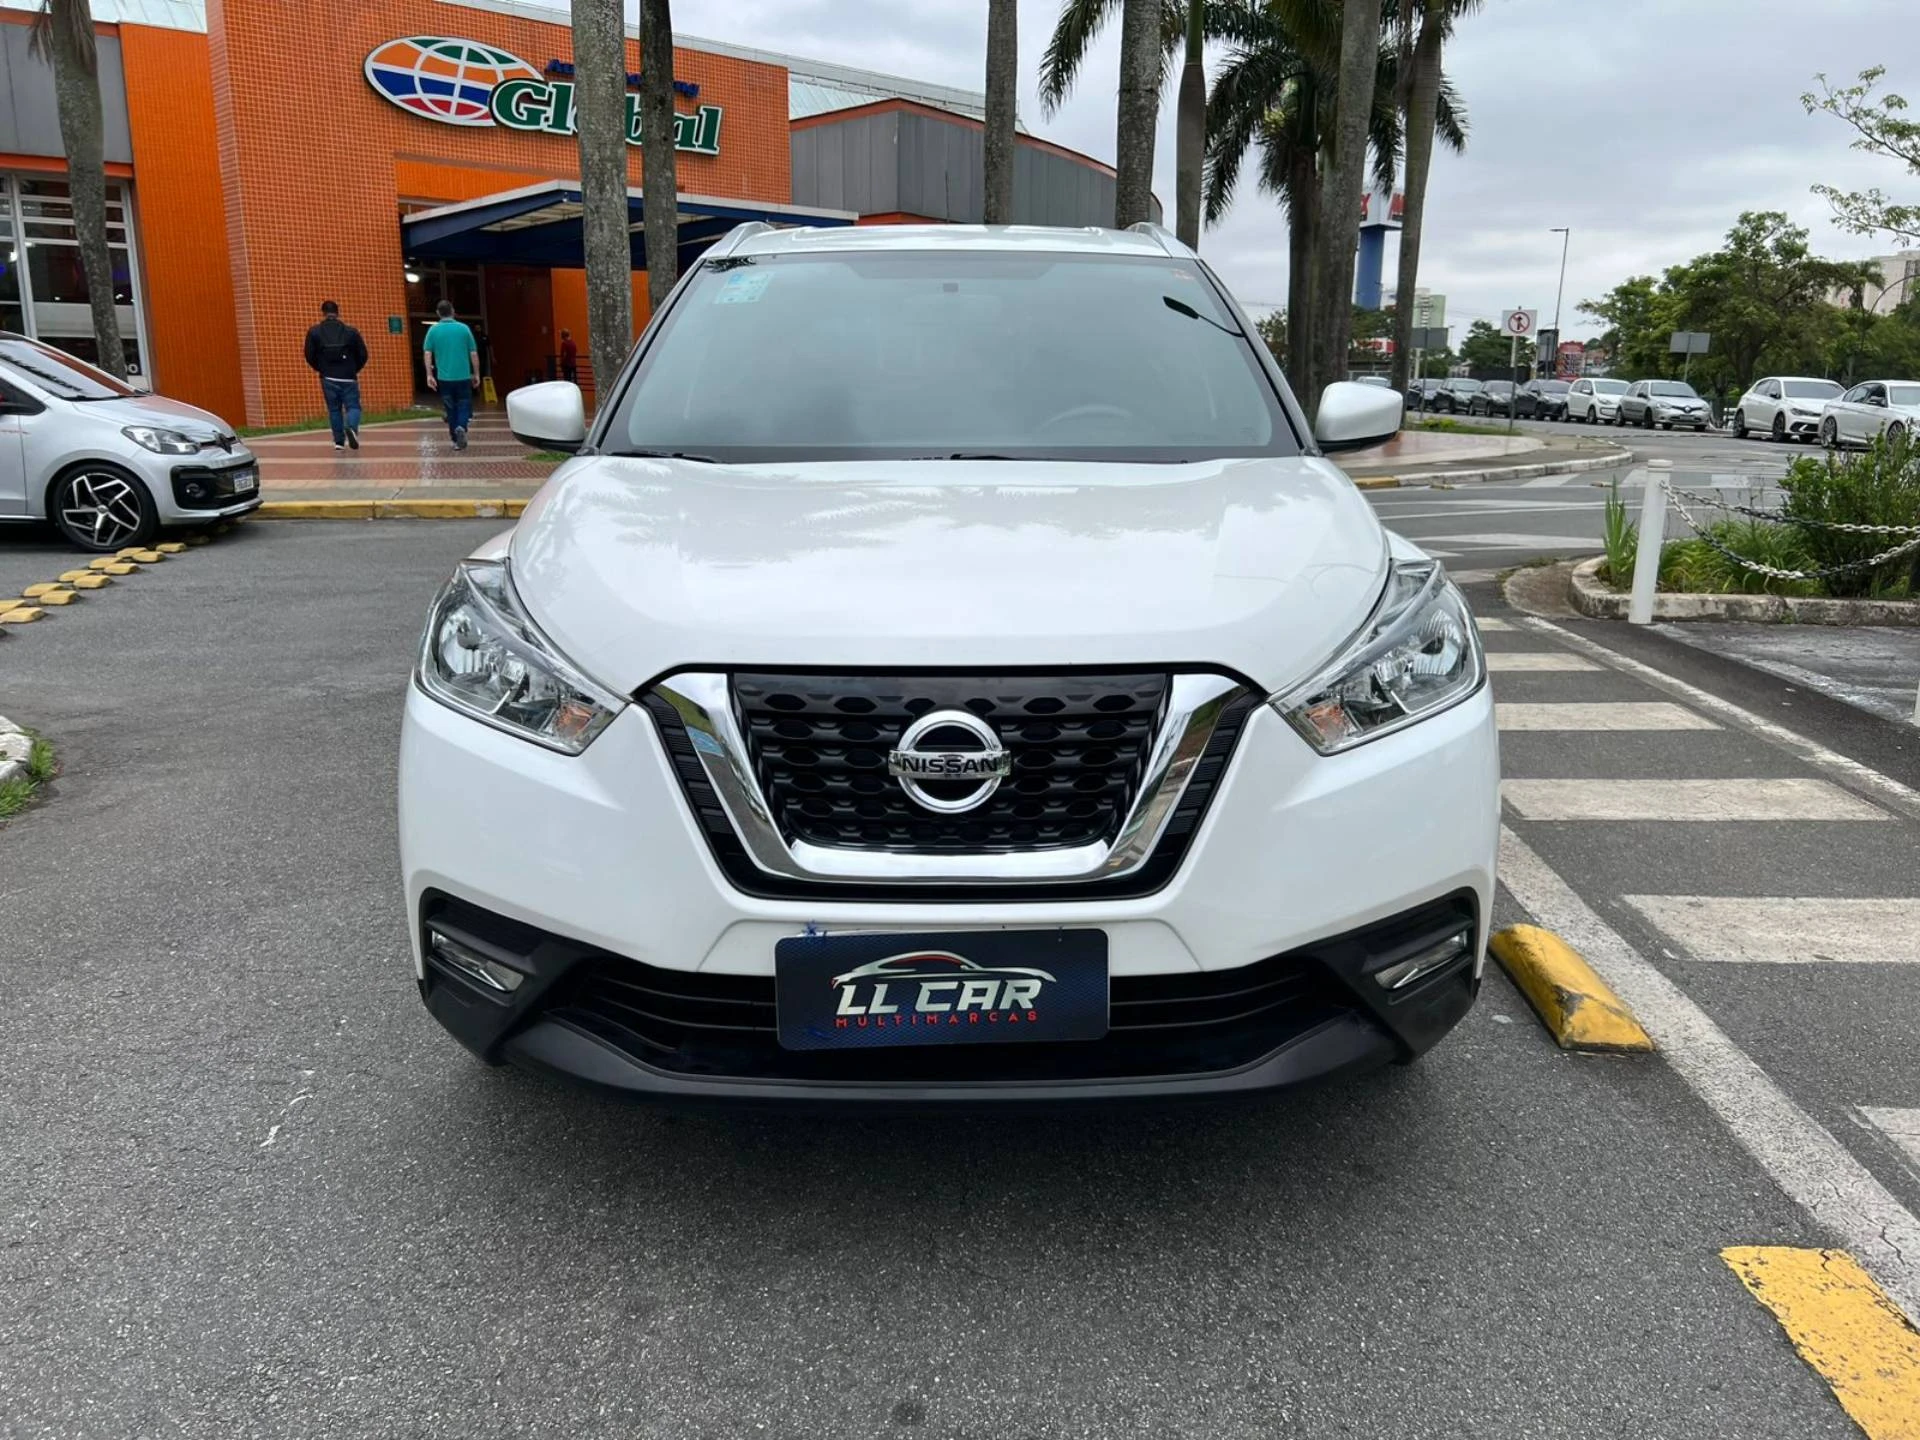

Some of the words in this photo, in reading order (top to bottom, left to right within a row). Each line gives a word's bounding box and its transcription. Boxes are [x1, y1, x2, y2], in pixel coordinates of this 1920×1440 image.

[492, 79, 722, 155] Glbal
[902, 758, 997, 773] NISSAN
[836, 983, 898, 1015] LL
[915, 979, 1042, 1012] CAR
[836, 1011, 1038, 1028] MULTIMARCAS
